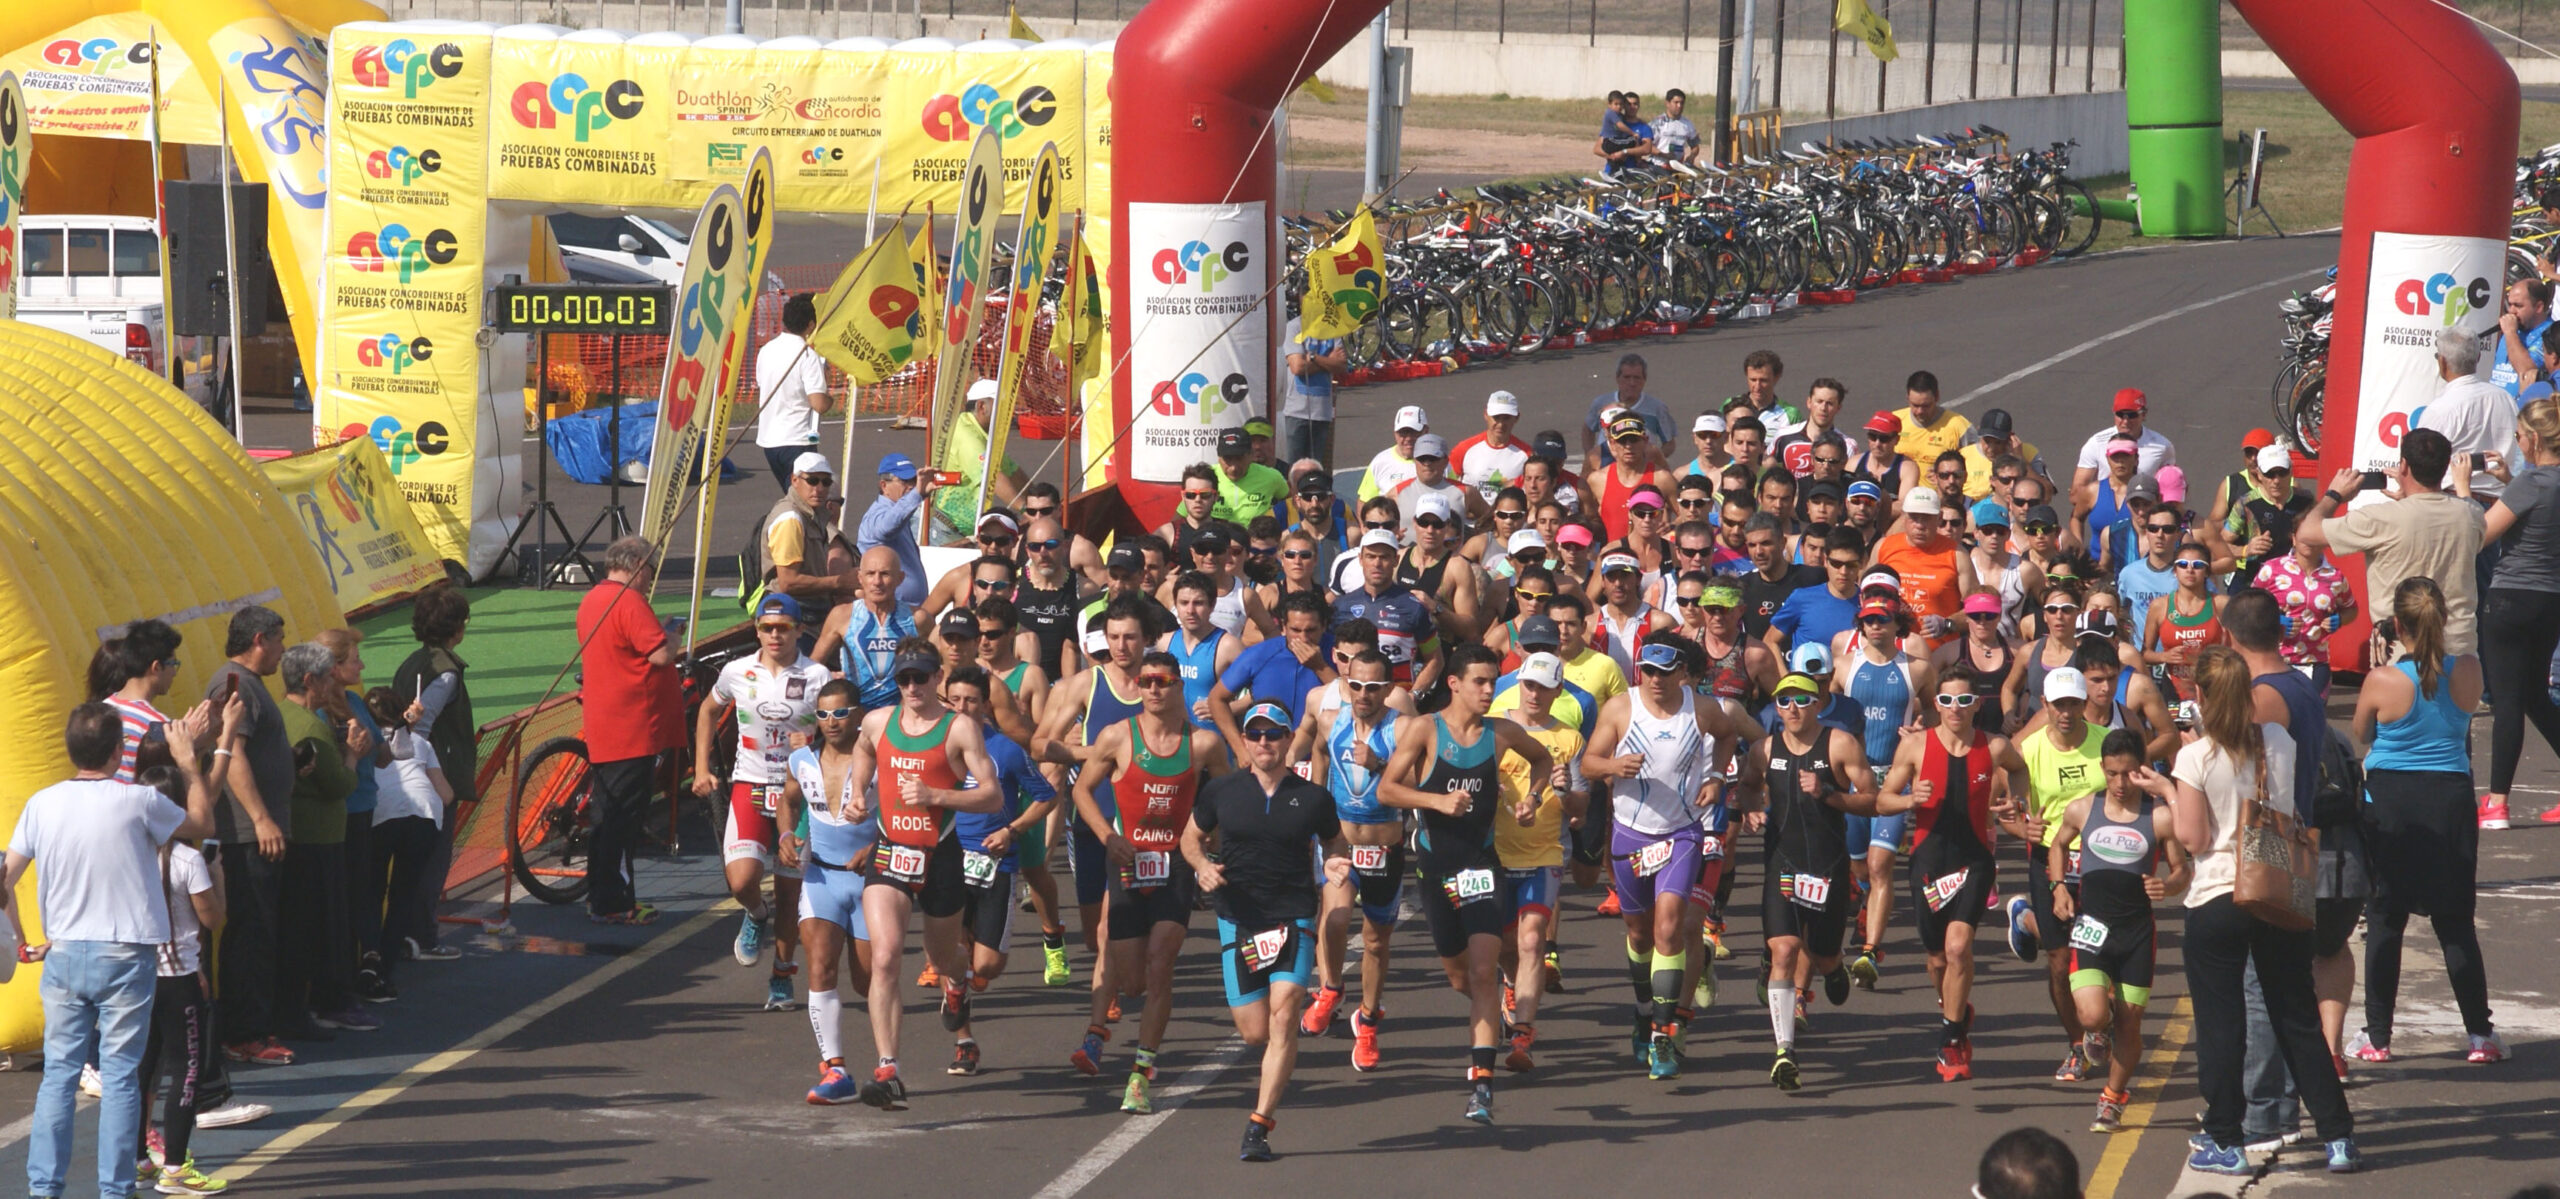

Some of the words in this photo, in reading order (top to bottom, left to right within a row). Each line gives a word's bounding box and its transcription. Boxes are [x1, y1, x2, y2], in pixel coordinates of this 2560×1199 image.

[23, 79, 75, 92] PRUEBAS
[79, 82, 152, 96] COMBINADA
[344, 101, 393, 115] ASOCIACION
[396, 103, 460, 119] CONCORDIENSE
[463, 107, 475, 119] DE
[717, 106, 751, 114] SPRINT
[343, 111, 392, 124] PRUEBAS
[397, 114, 474, 127] COMBINADAS
[732, 126, 768, 136] CIRCUITO
[771, 127, 825, 137] ENTRERRIANO
[827, 127, 838, 137] DE
[840, 127, 881, 137] DUATHLON
[502, 144, 560, 156] ASOCIACION
[565, 147, 640, 160] CONCORDIENSE
[644, 152, 655, 161] DE
[501, 154, 559, 170] PRUEBAS
[565, 158, 656, 175] COMBINADAS
[913, 159, 967, 169] ASOCIACIO
[913, 169, 966, 182] PRUEBA
[397, 196, 450, 206] COMBINADAS
[338, 286, 387, 297] ASOCIACION
[390, 288, 454, 301] CONCORDIENSE
[457, 292, 467, 302] DE
[1147, 296, 1191, 305] ASOCIACION
[1193, 295, 1250, 305] CONCORDIENSE
[338, 296, 386, 310] PRUEBAS
[390, 298, 467, 313] COMBINADAS
[1146, 304, 1191, 316] PRUEBAS
[1195, 303, 1258, 316] COMBINADAS
[2384, 326, 2432, 338] ASOCIACION
[2383, 335, 2430, 348] PRUEBAS
[352, 382, 385, 393] PRUEBAS
[387, 384, 440, 396] COMBINADAS
[1145, 428, 1190, 438] ASOCIACION
[1145, 437, 1190, 448] PRUEBAS
[447, 484, 458, 494] DE
[867, 640, 898, 651] ARG
[892, 815, 933, 831] RODE
[1132, 828, 1174, 843] CAINO
[2096, 832, 2111, 844] La
[895, 854, 921, 873] 067
[1355, 849, 1385, 867] 057
[964, 859, 994, 879] 263
[1138, 860, 1166, 878] 001
[1461, 876, 1491, 895] 246
[1798, 881, 1824, 901] 111
[2073, 923, 2103, 943] 289
